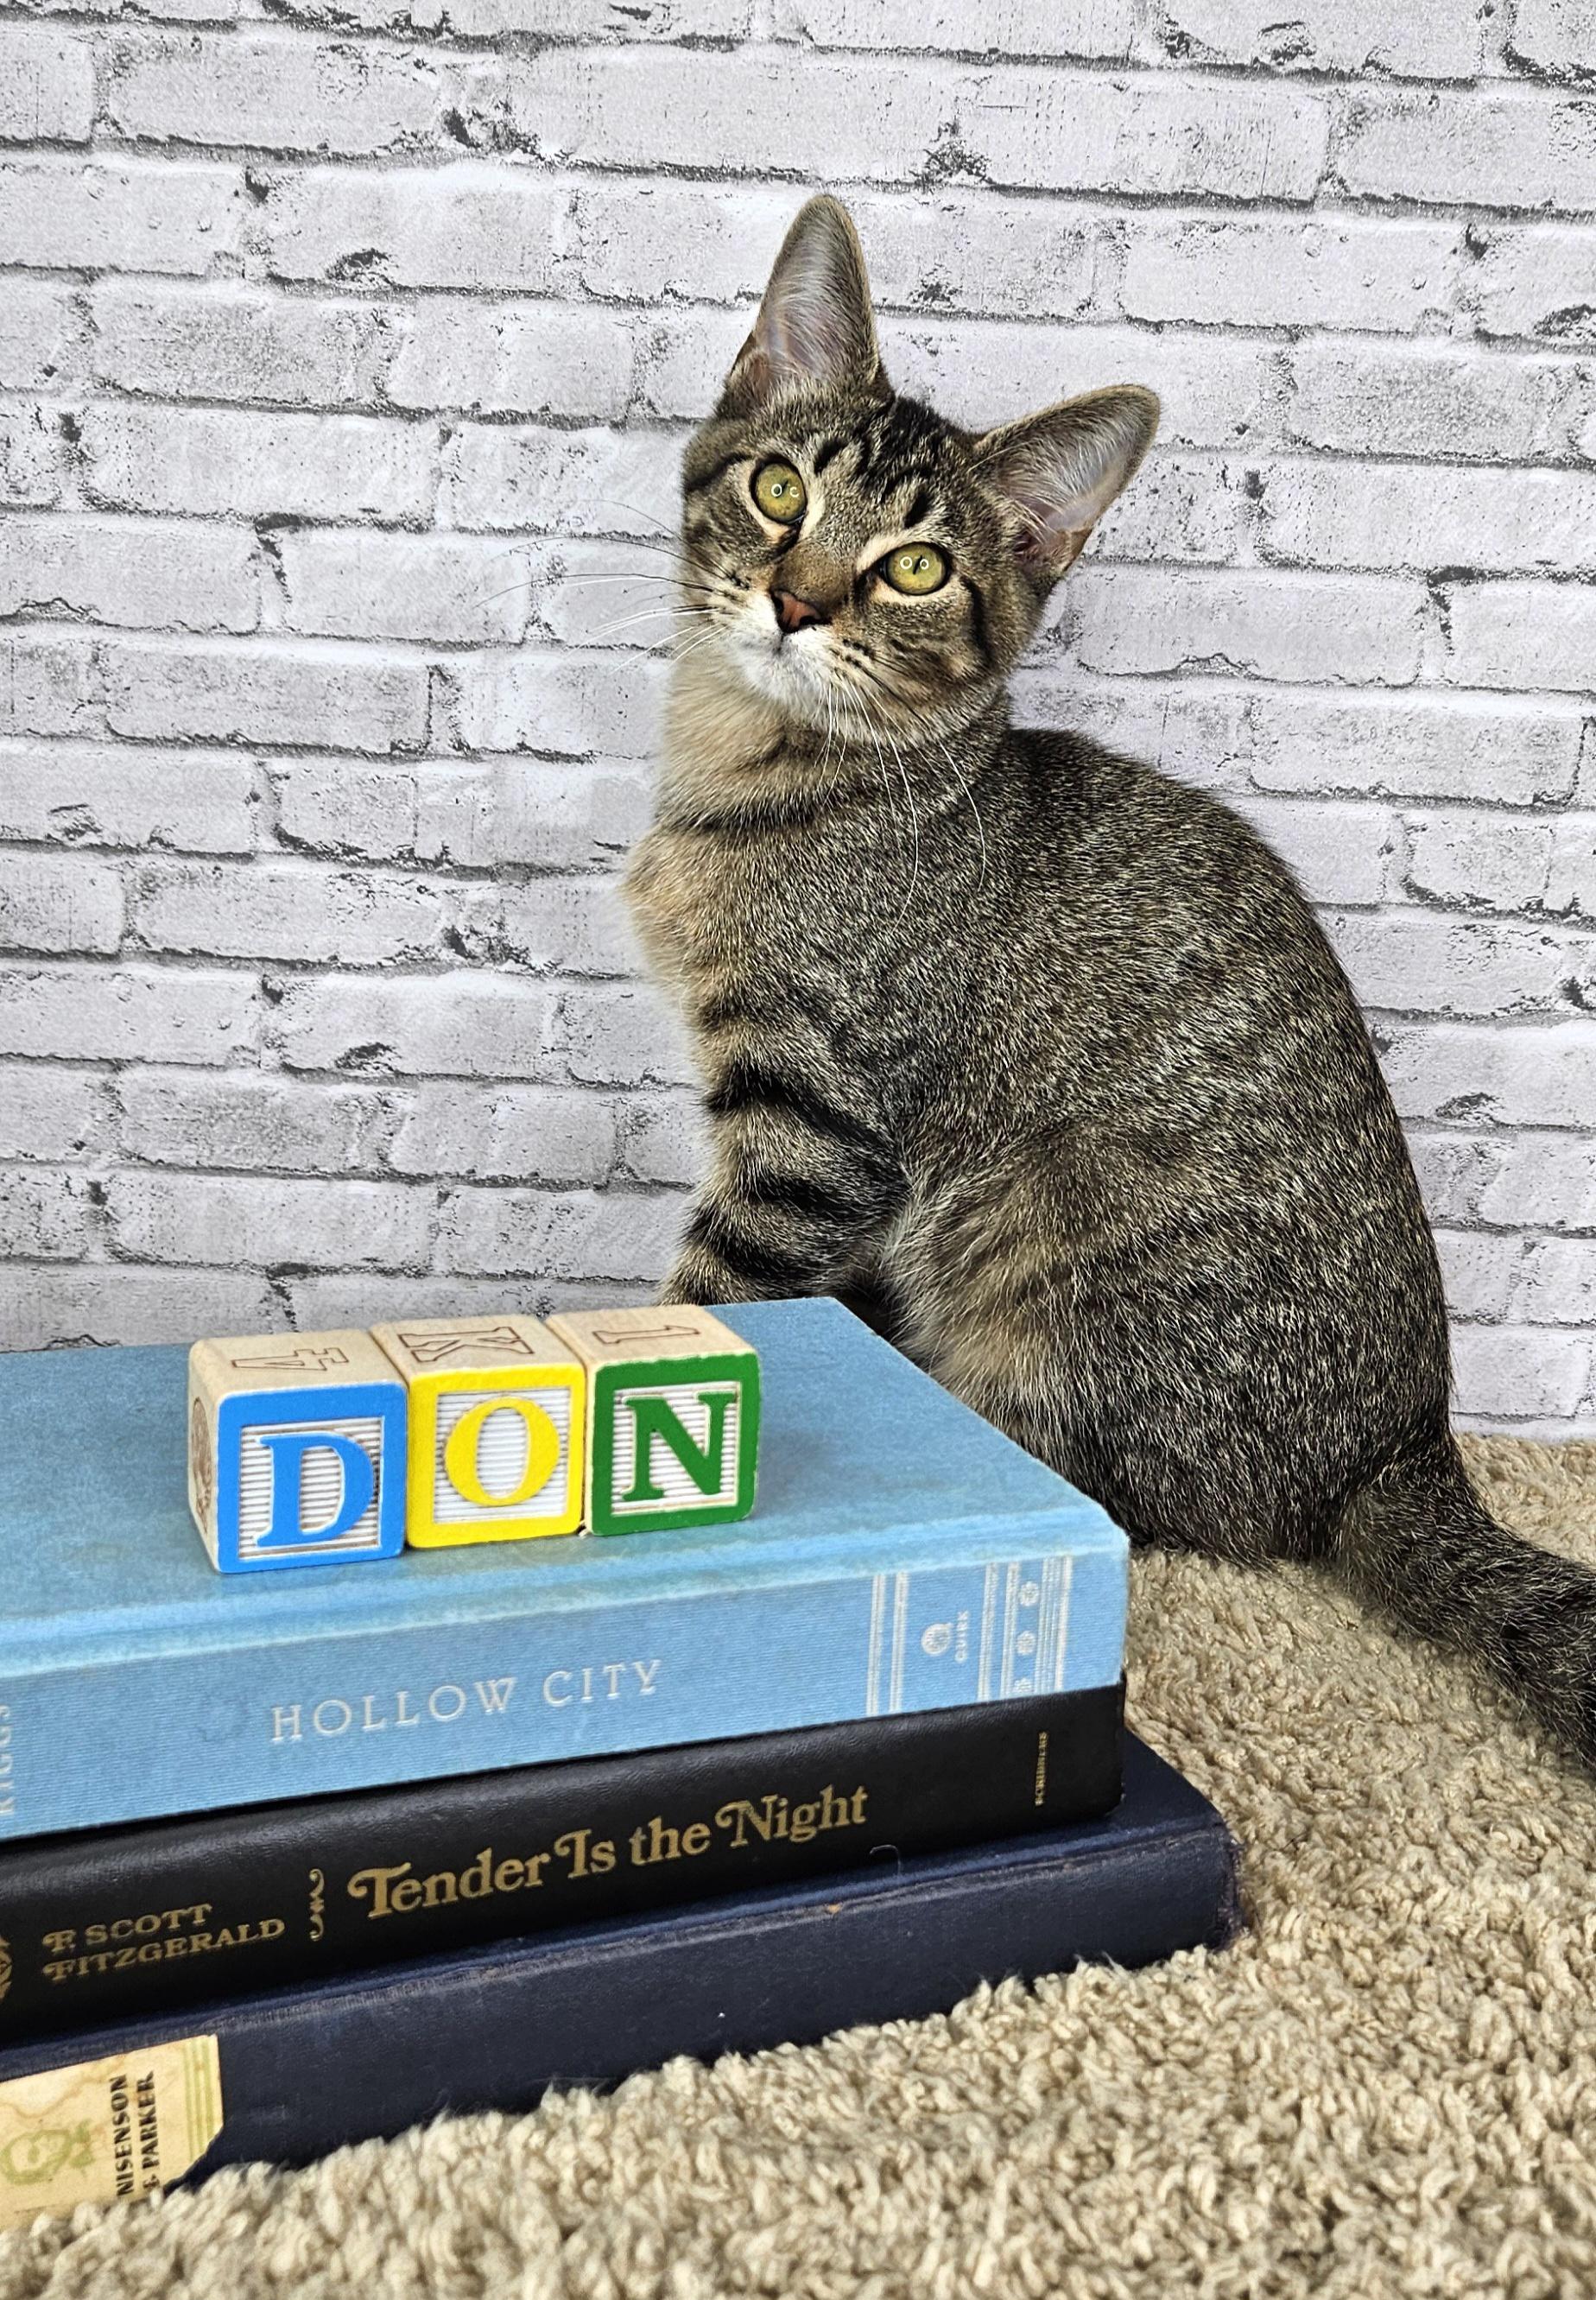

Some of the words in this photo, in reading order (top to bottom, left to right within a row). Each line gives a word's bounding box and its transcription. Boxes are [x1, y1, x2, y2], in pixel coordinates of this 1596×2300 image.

[270, 1676, 518, 1743] HOLLOW
[542, 1658, 662, 1708] CITY
[347, 1847, 550, 1919] Tender
[554, 1828, 616, 1879] Is
[630, 1818, 712, 1865] the
[715, 1784, 869, 1849] Night
[41, 1917, 286, 1981] FITZGERALD
[85, 1903, 213, 1947] SCOTT
[110, 2075, 133, 2196] NISENSON
[136, 2070, 160, 2170] PARKER
